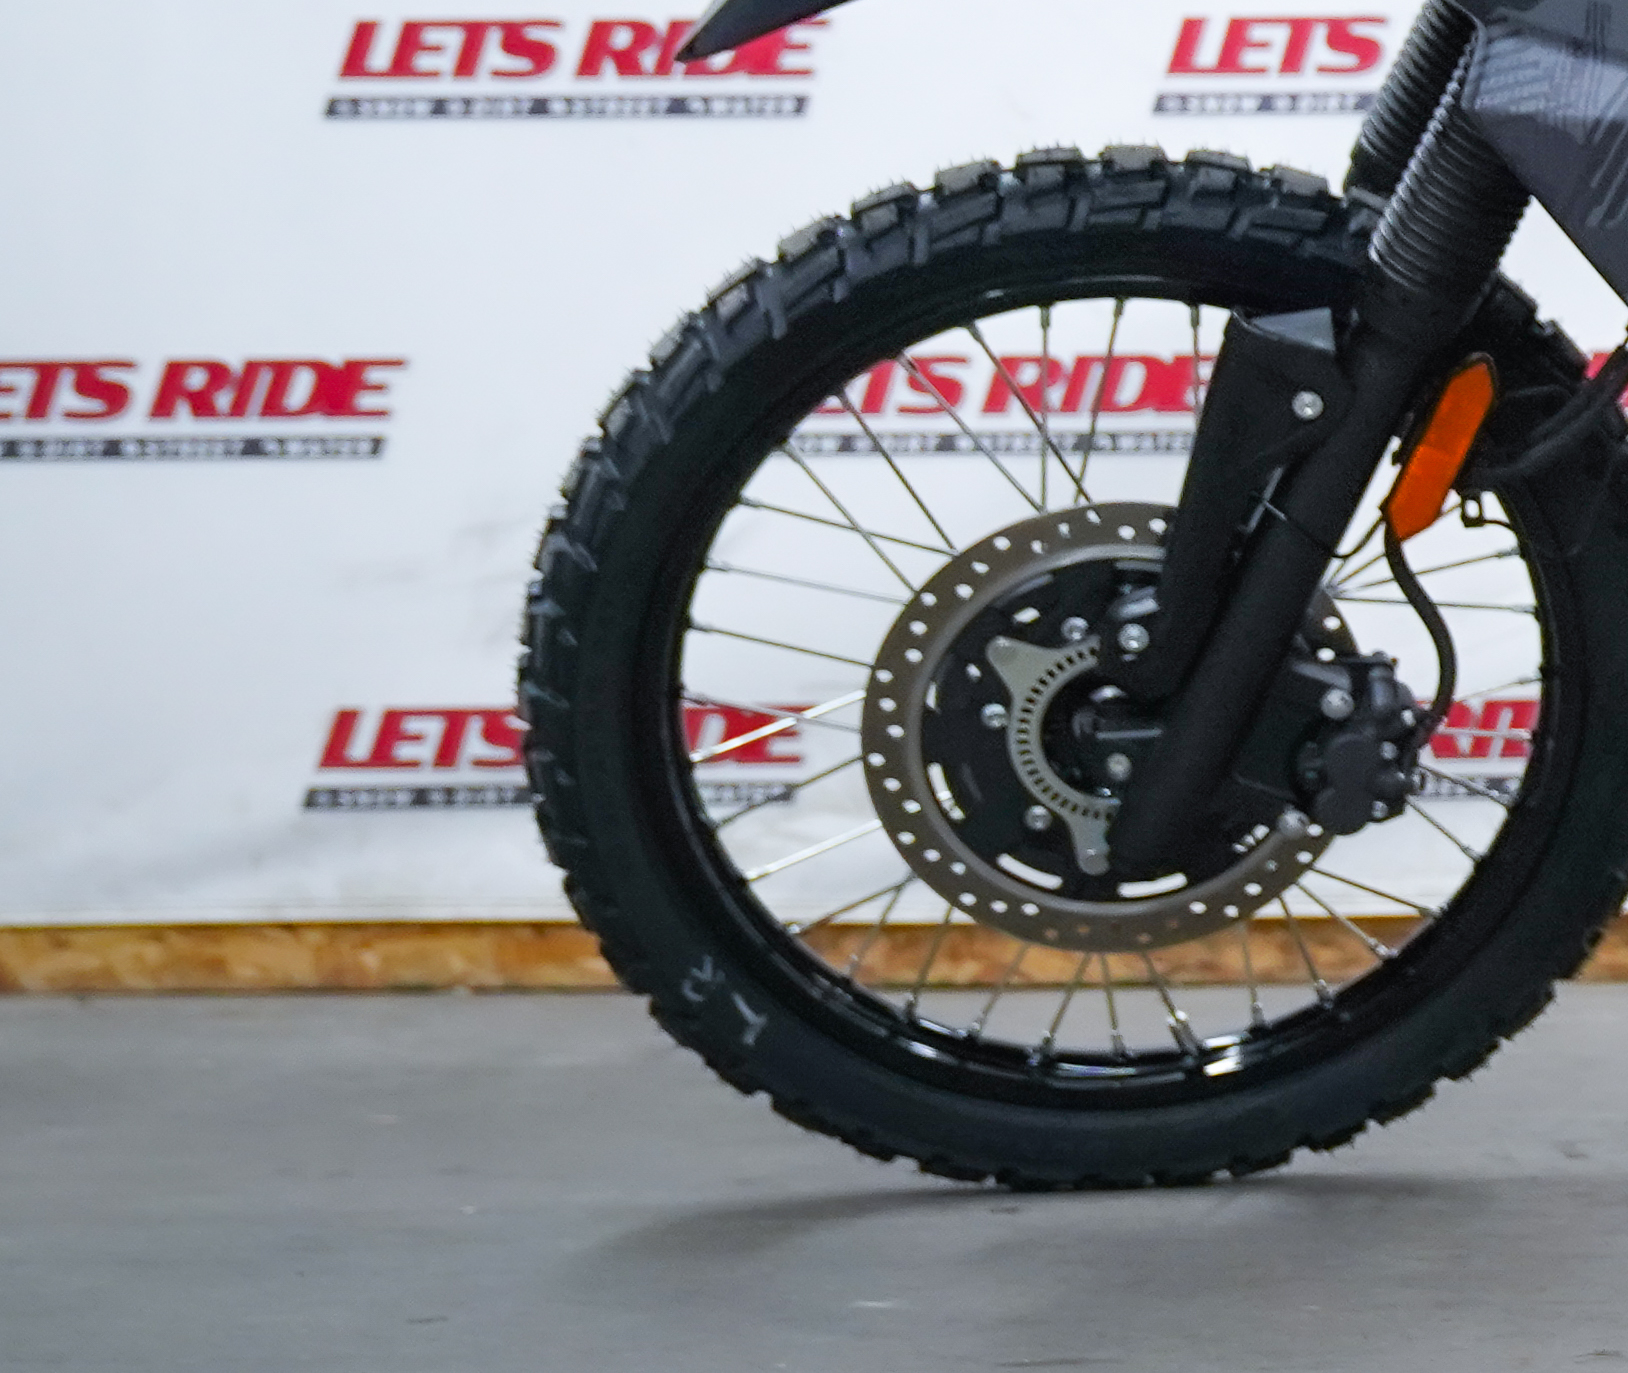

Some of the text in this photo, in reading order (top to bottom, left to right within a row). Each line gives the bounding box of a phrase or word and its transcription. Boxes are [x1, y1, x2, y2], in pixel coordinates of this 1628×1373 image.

[340, 20, 563, 78] LETS
[1168, 17, 1388, 75] LETS
[0, 360, 405, 420] TS RIDE
[815, 353, 1216, 415] TS RIDE
[319, 709, 525, 769] LETS
